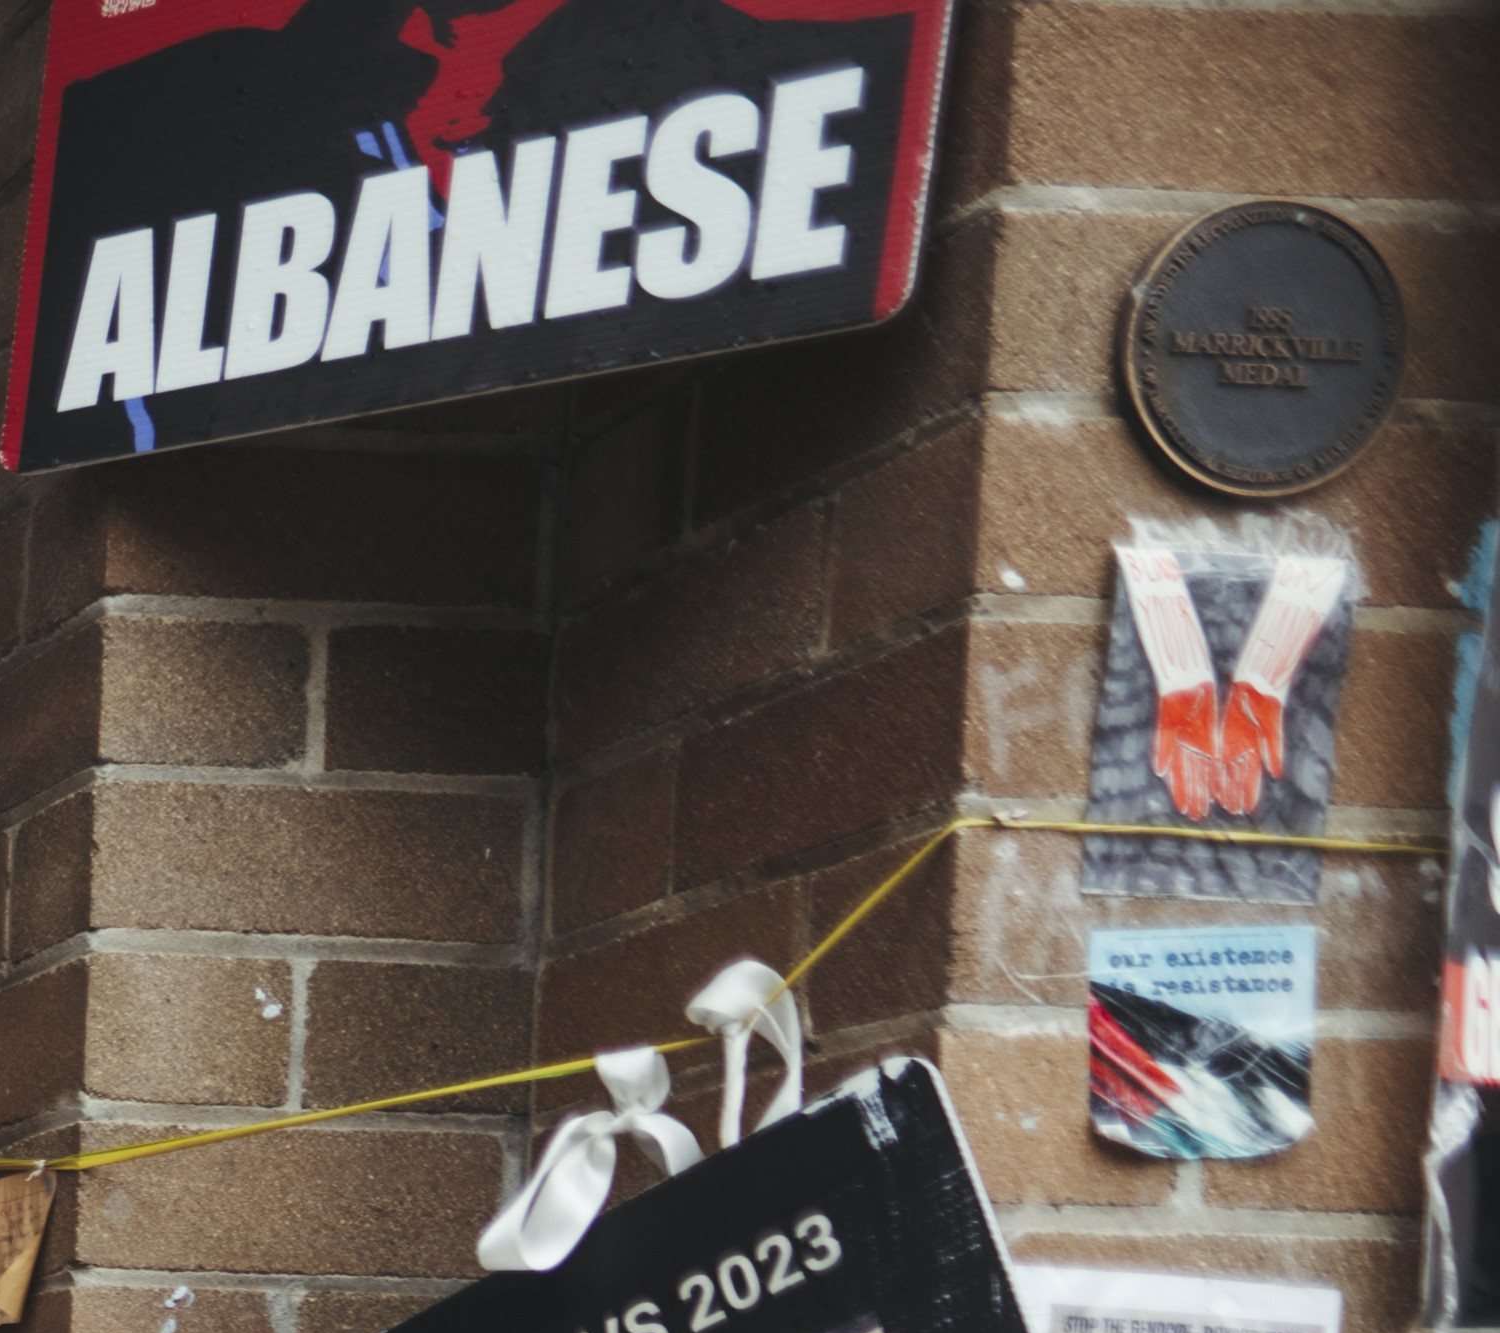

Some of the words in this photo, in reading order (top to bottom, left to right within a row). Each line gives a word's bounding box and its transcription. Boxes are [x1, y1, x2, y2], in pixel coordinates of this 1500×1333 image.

[57, 66, 864, 412] ALBANESE
[1169, 331, 1366, 361] MARRICKVILLE
[1216, 361, 1308, 388] MEDAL
[1108, 953, 1152, 969] our
[1166, 948, 1294, 968] existence
[1151, 976, 1294, 996] resistance
[678, 1213, 844, 1332] 2023
